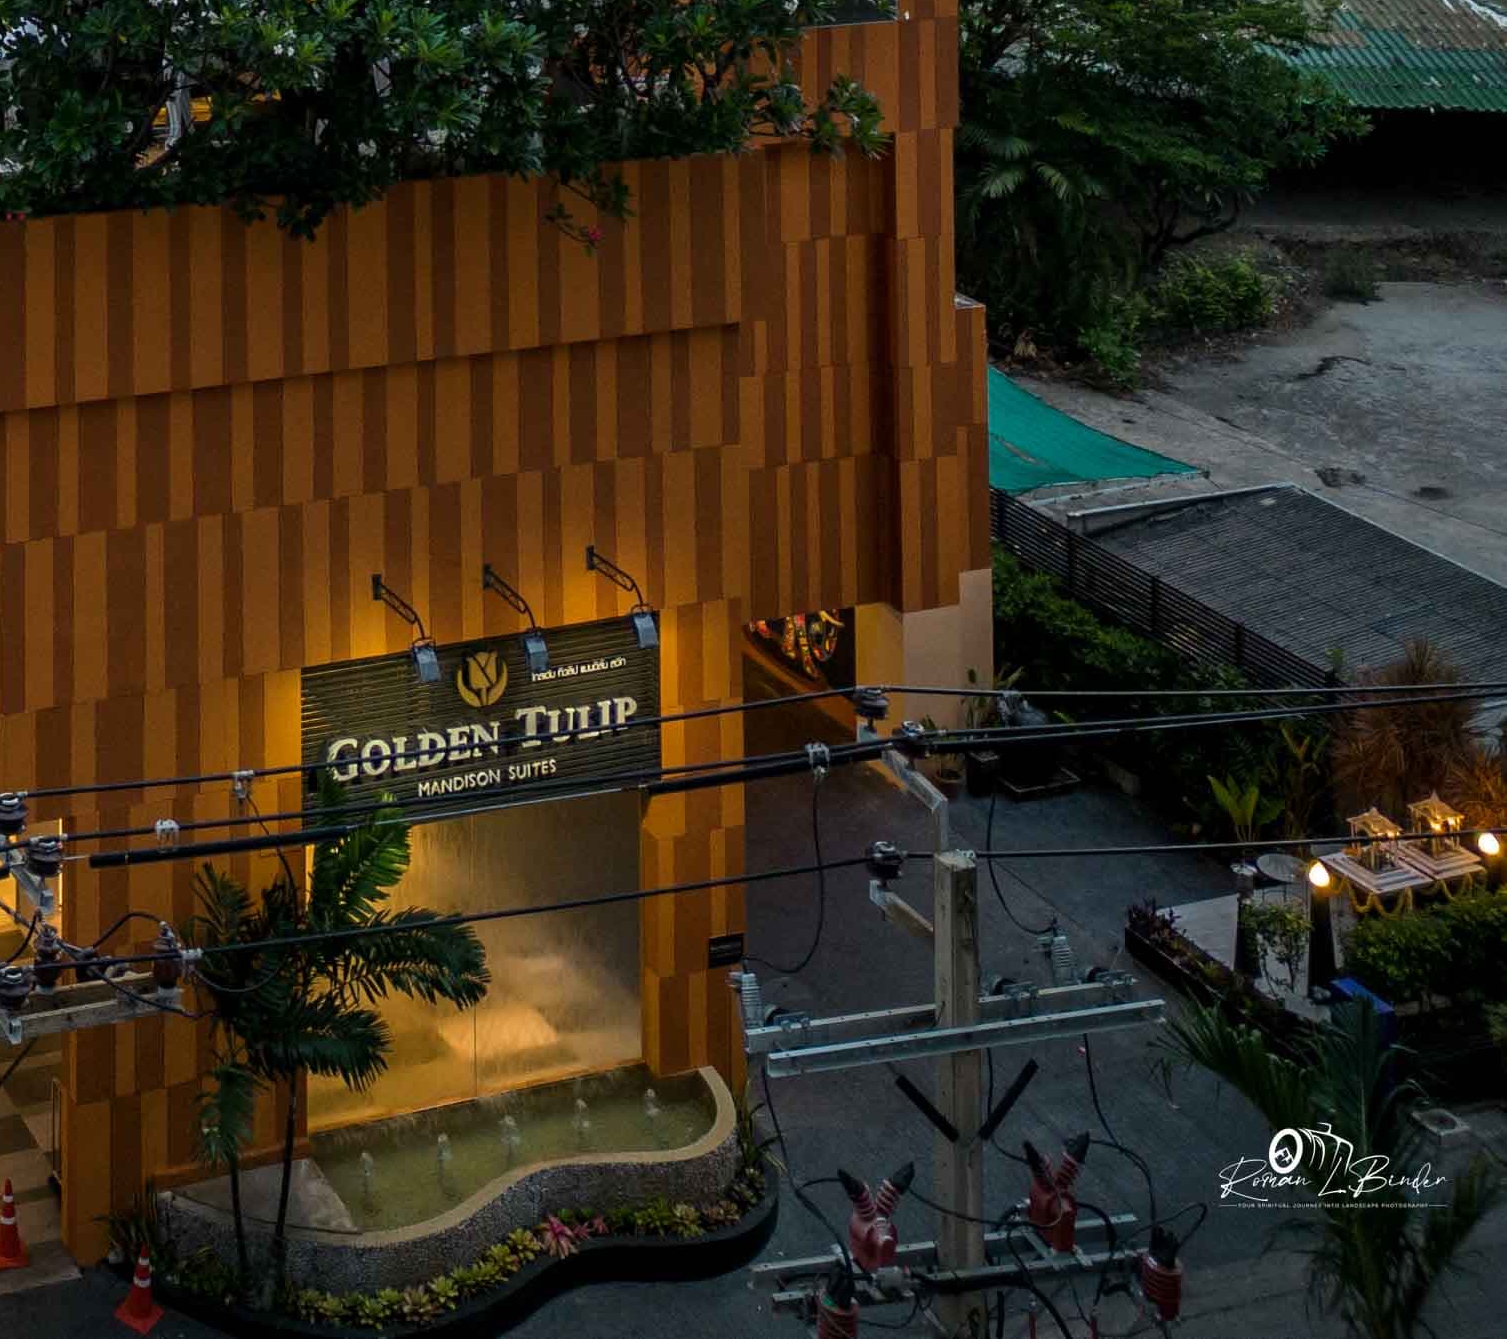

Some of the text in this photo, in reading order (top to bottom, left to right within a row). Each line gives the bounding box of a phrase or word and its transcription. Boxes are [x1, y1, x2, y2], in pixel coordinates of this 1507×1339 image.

[327, 696, 637, 781] GOLDEN TULIP
[417, 758, 557, 798] MANDISON SUITES
